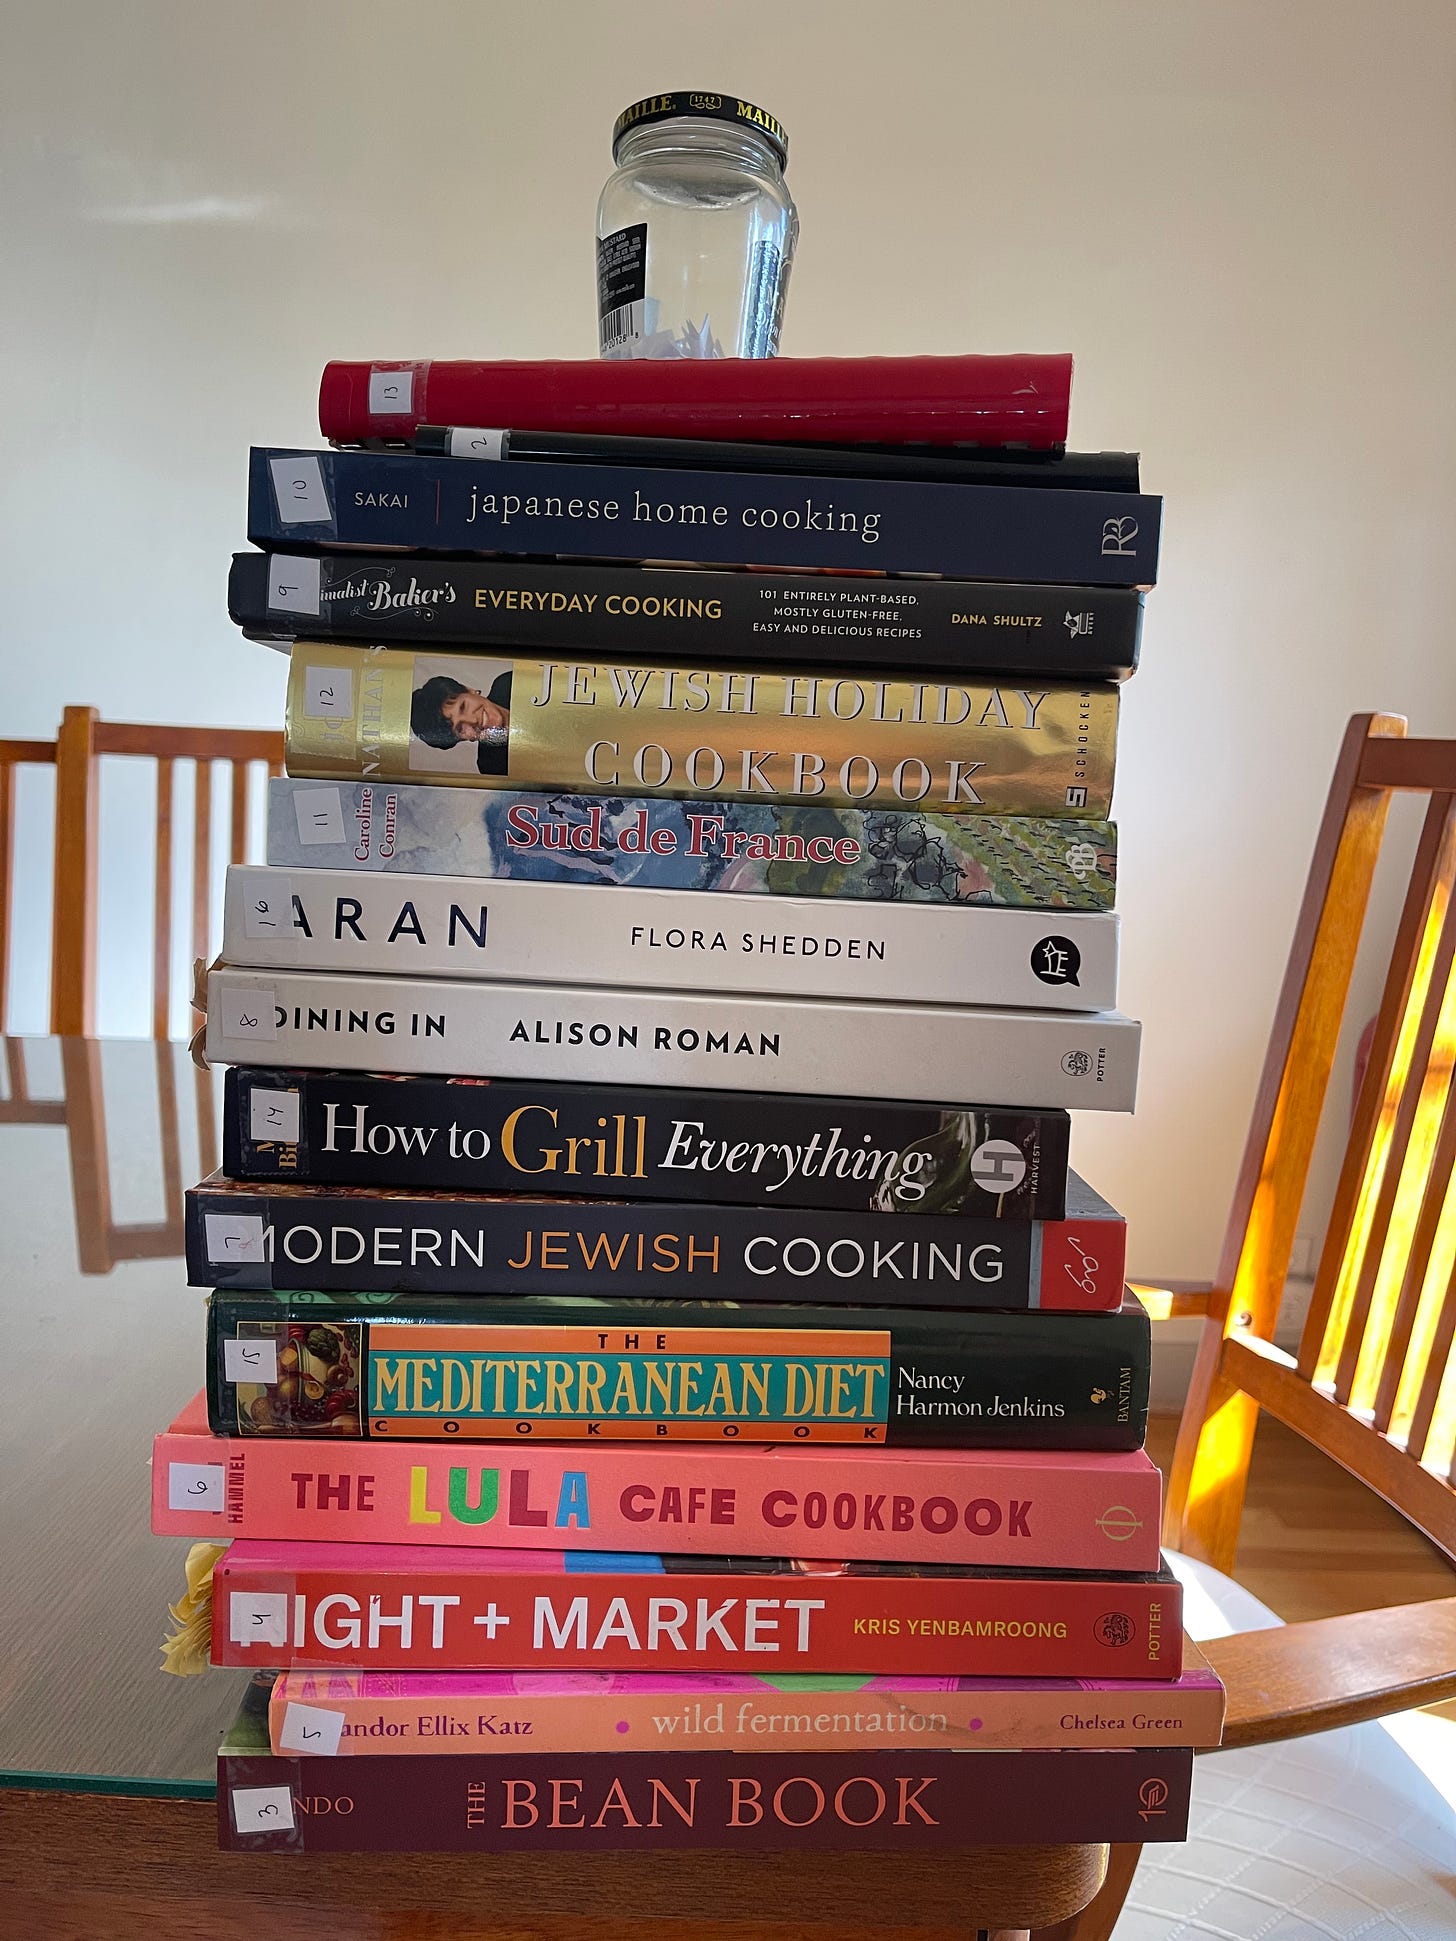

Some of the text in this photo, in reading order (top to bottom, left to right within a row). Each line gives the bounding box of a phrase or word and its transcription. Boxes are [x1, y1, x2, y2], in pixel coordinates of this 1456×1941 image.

[384, 386, 398, 400] 13
[471, 437, 488, 450] 2
[292, 480, 308, 500] 10
[354, 491, 409, 509] SAKAI
[466, 485, 882, 545] japanese home cooking
[320, 577, 456, 611] imalist Baker's
[474, 588, 723, 620] EVERYDAY COOKING
[759, 589, 777, 600] 101
[783, 590, 837, 603] ENTIRELY
[774, 606, 820, 619] MOSTLY
[951, 613, 1043, 628] DANA SHULTZ
[753, 623, 922, 639] EASY AND DELICIOUS RECIPES
[320, 687, 334, 706] 12
[532, 662, 1050, 730] JEWISH HOLIDAY
[1075, 691, 1090, 778] SCHOCKEN
[584, 740, 986, 806] COOKBOOK
[313, 813, 328, 826] 11
[354, 787, 374, 862] Caroline
[379, 793, 397, 858] Conran
[505, 805, 861, 866] Sud de France
[631, 927, 886, 960] FLORA SHEDDEN
[239, 1013, 258, 1027] 8
[411, 1013, 445, 1038] IN
[509, 1019, 781, 1057] ALISON ROMAN
[1096, 1047, 1106, 1082] POTTER
[267, 1106, 284, 1126] 14
[320, 1102, 439, 1156] How
[449, 1120, 491, 1160] to
[500, 1104, 649, 1180] Grill
[657, 1119, 932, 1202] Everything
[1031, 1143, 1041, 1195] HARVEST
[507, 1229, 720, 1274] JEWISH
[744, 1235, 1004, 1284] COOKING
[598, 1332, 667, 1350] THE
[373, 1356, 885, 1419] MEDITERRANEAN DIET
[898, 1366, 965, 1394] Nancy
[1117, 1367, 1131, 1422] BANTAM
[897, 1394, 1066, 1419] Harmon Jenkins
[228, 1453, 245, 1524] HAMMEL
[291, 1465, 1034, 1538] THE LULA CAFE COOKBOOK
[241, 1593, 825, 1651] IGHT + MARKET
[853, 1618, 1068, 1639] KRIS YENBAMROONG
[1148, 1602, 1162, 1661] POTTER
[341, 1714, 534, 1737] andor Ellix Katz
[652, 1700, 948, 1735] wild fermentation
[1059, 1714, 1183, 1731] Chelsea Green
[258, 1804, 279, 1818] 3
[292, 1795, 354, 1815] NDO
[466, 1780, 486, 1829] THE
[500, 1776, 940, 1829] BEAN BOOK
